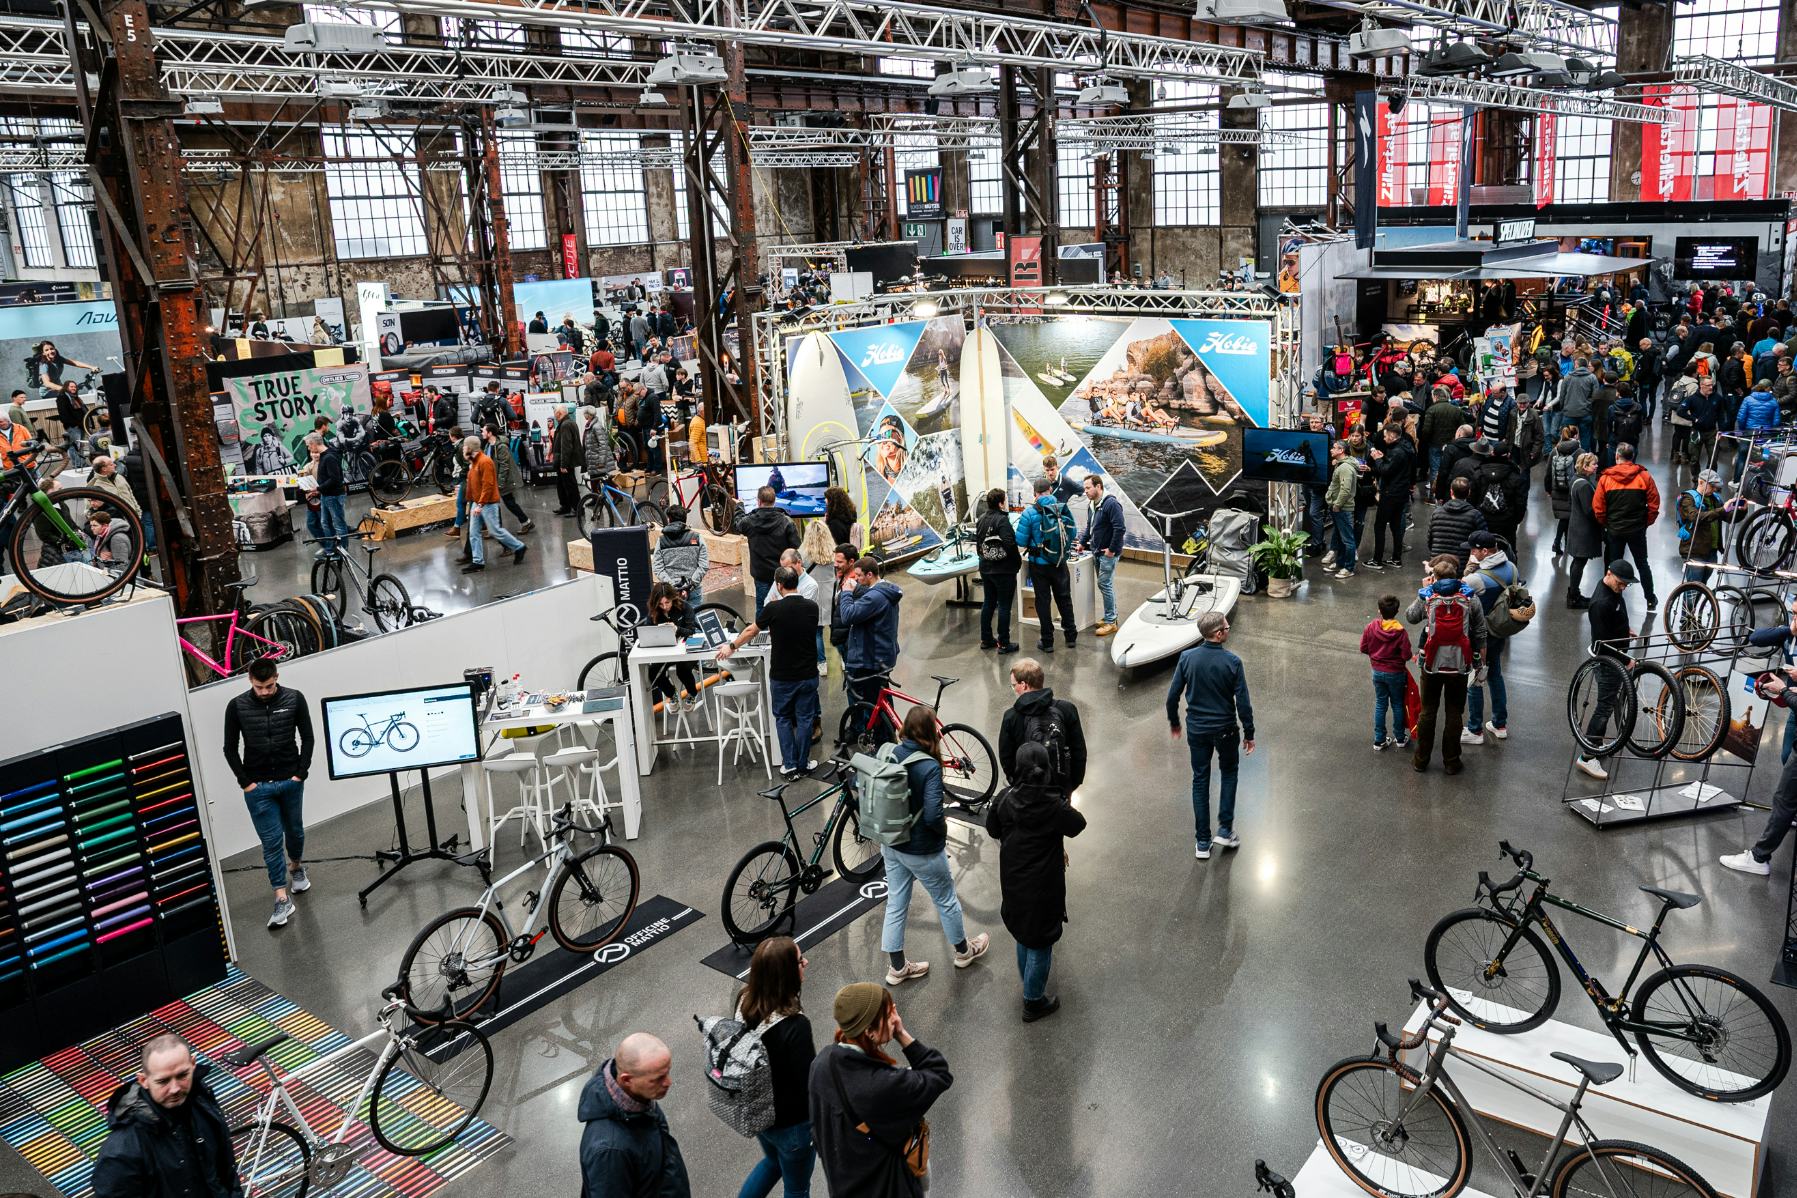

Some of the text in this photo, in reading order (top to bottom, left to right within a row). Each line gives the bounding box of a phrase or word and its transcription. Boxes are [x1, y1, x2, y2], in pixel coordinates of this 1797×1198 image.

[124, 14, 134, 27] E
[127, 29, 137, 42] 5
[951, 226, 963, 235] CAR
[954, 235, 960, 243] IS
[860, 342, 905, 368] Hobie
[1198, 331, 1258, 355] Hobie
[248, 376, 302, 401] TRUE
[253, 394, 322, 422] STORY.
[1265, 448, 1306, 465] Hobie
[616, 557, 631, 601] MATTIO
[623, 917, 671, 944] OFFICINE
[630, 923, 671, 947] MATTIO
